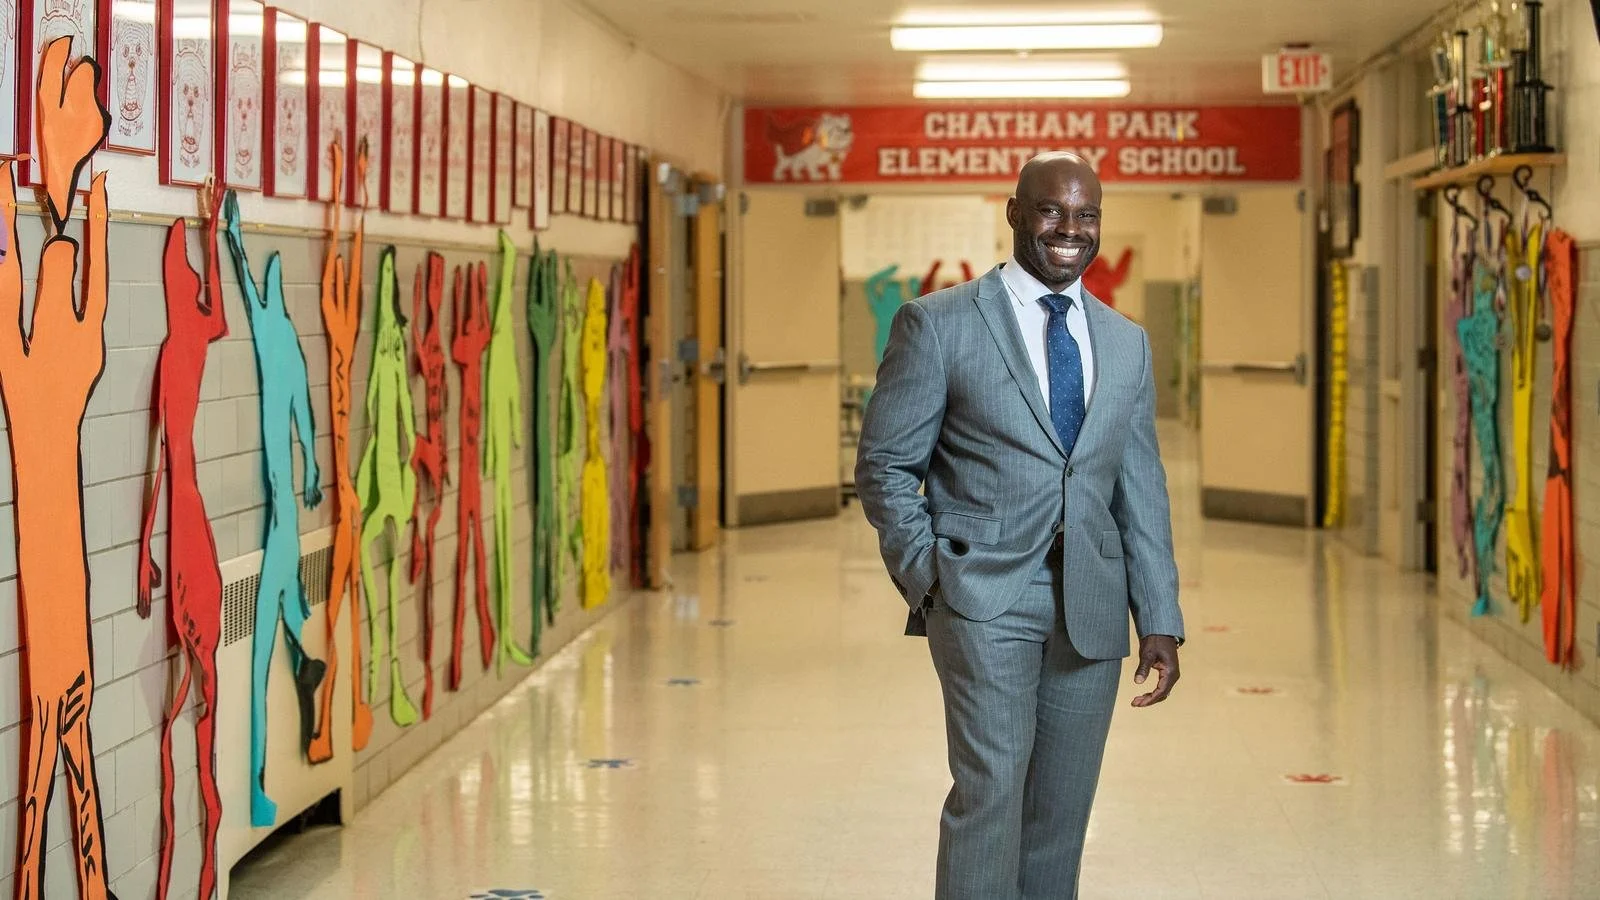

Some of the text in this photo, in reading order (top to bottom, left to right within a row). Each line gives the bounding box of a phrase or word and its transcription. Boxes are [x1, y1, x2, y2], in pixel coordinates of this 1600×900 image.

[1278, 54, 1321, 87] EXIT
[924, 111, 1199, 139] CHATHAM PARK
[878, 146, 1246, 175] ELEMENTY SCHOOL
